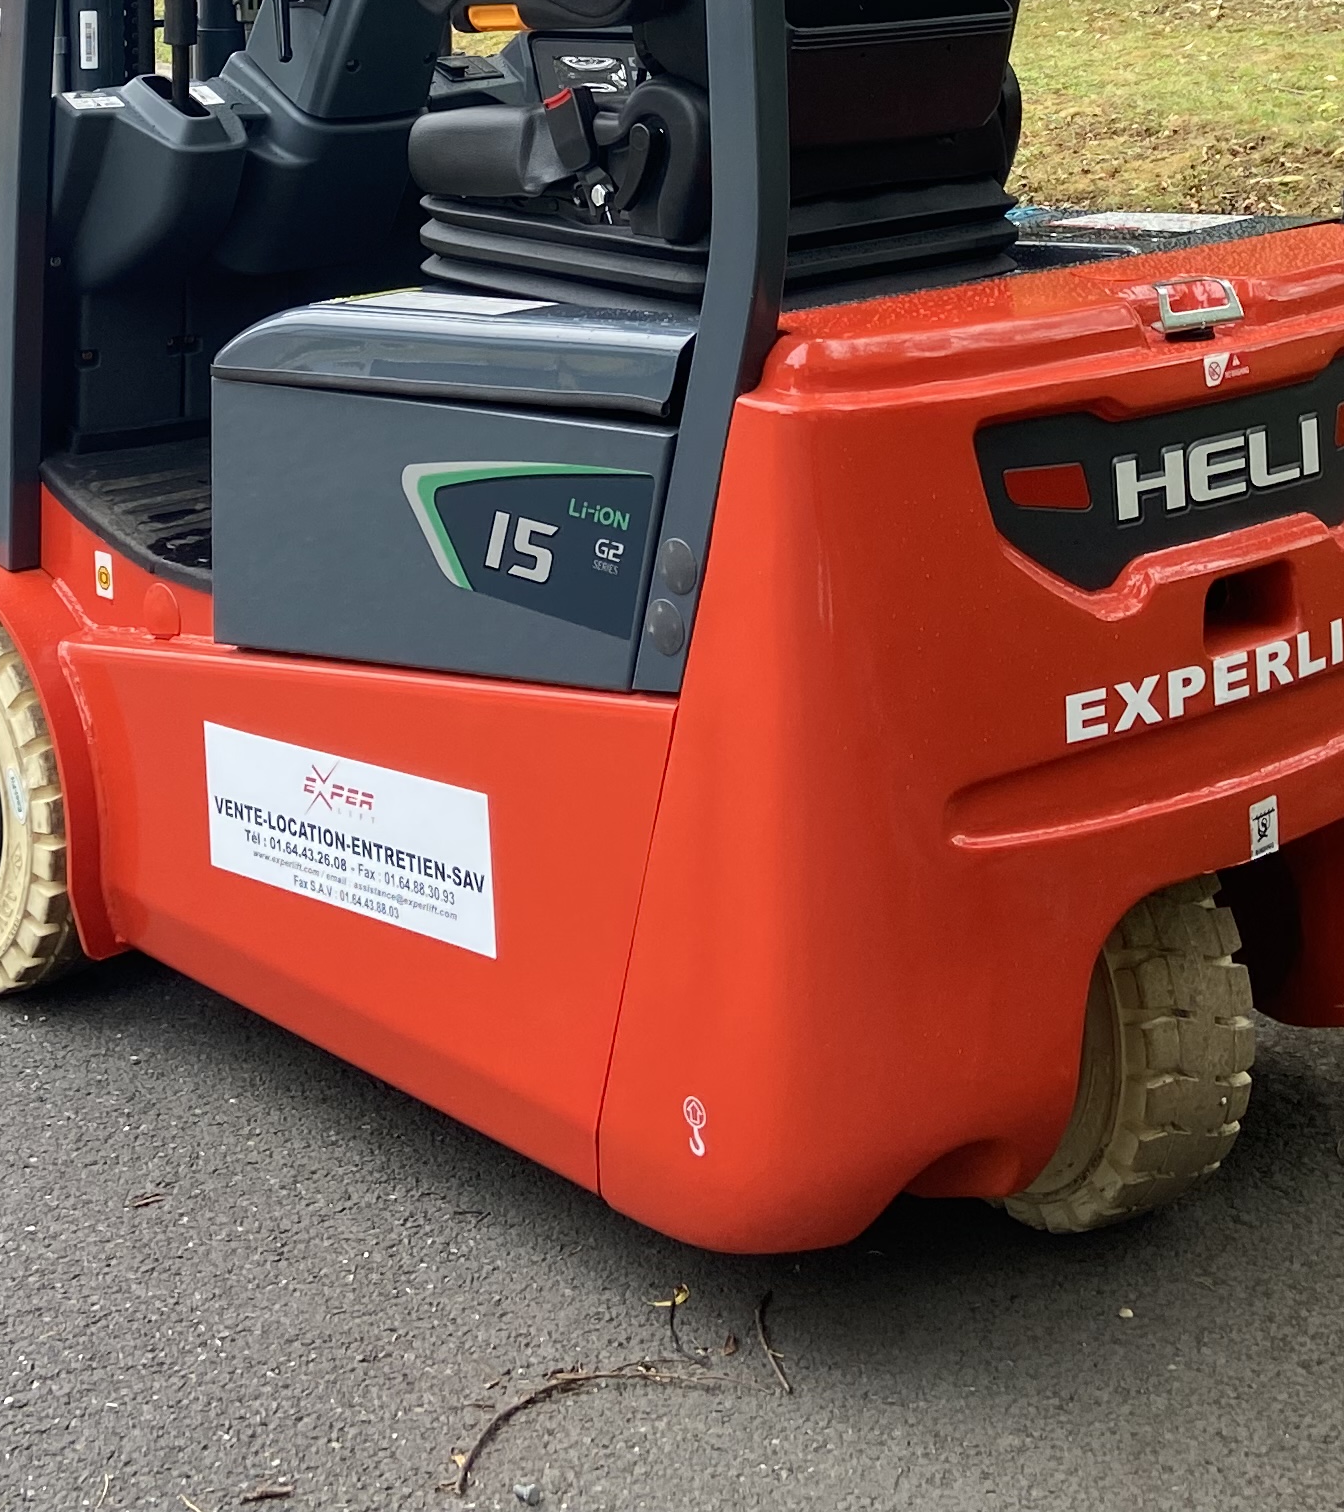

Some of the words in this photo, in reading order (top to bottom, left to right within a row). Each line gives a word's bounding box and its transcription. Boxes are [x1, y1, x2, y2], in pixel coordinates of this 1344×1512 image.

[1113, 416, 1321, 522] HELI
[484, 510, 559, 583] 15
[592, 559, 619, 576] SERIES
[594, 538, 625, 563] G2
[214, 795, 485, 894] VENTE-LOCATION-ENTRETIEN-SAV
[269, 836, 347, 872] 01.64.43.26.08
[357, 863, 376, 881] Fax
[384, 871, 455, 906] 01.64.88.30.93
[293, 874, 309, 890] Fax
